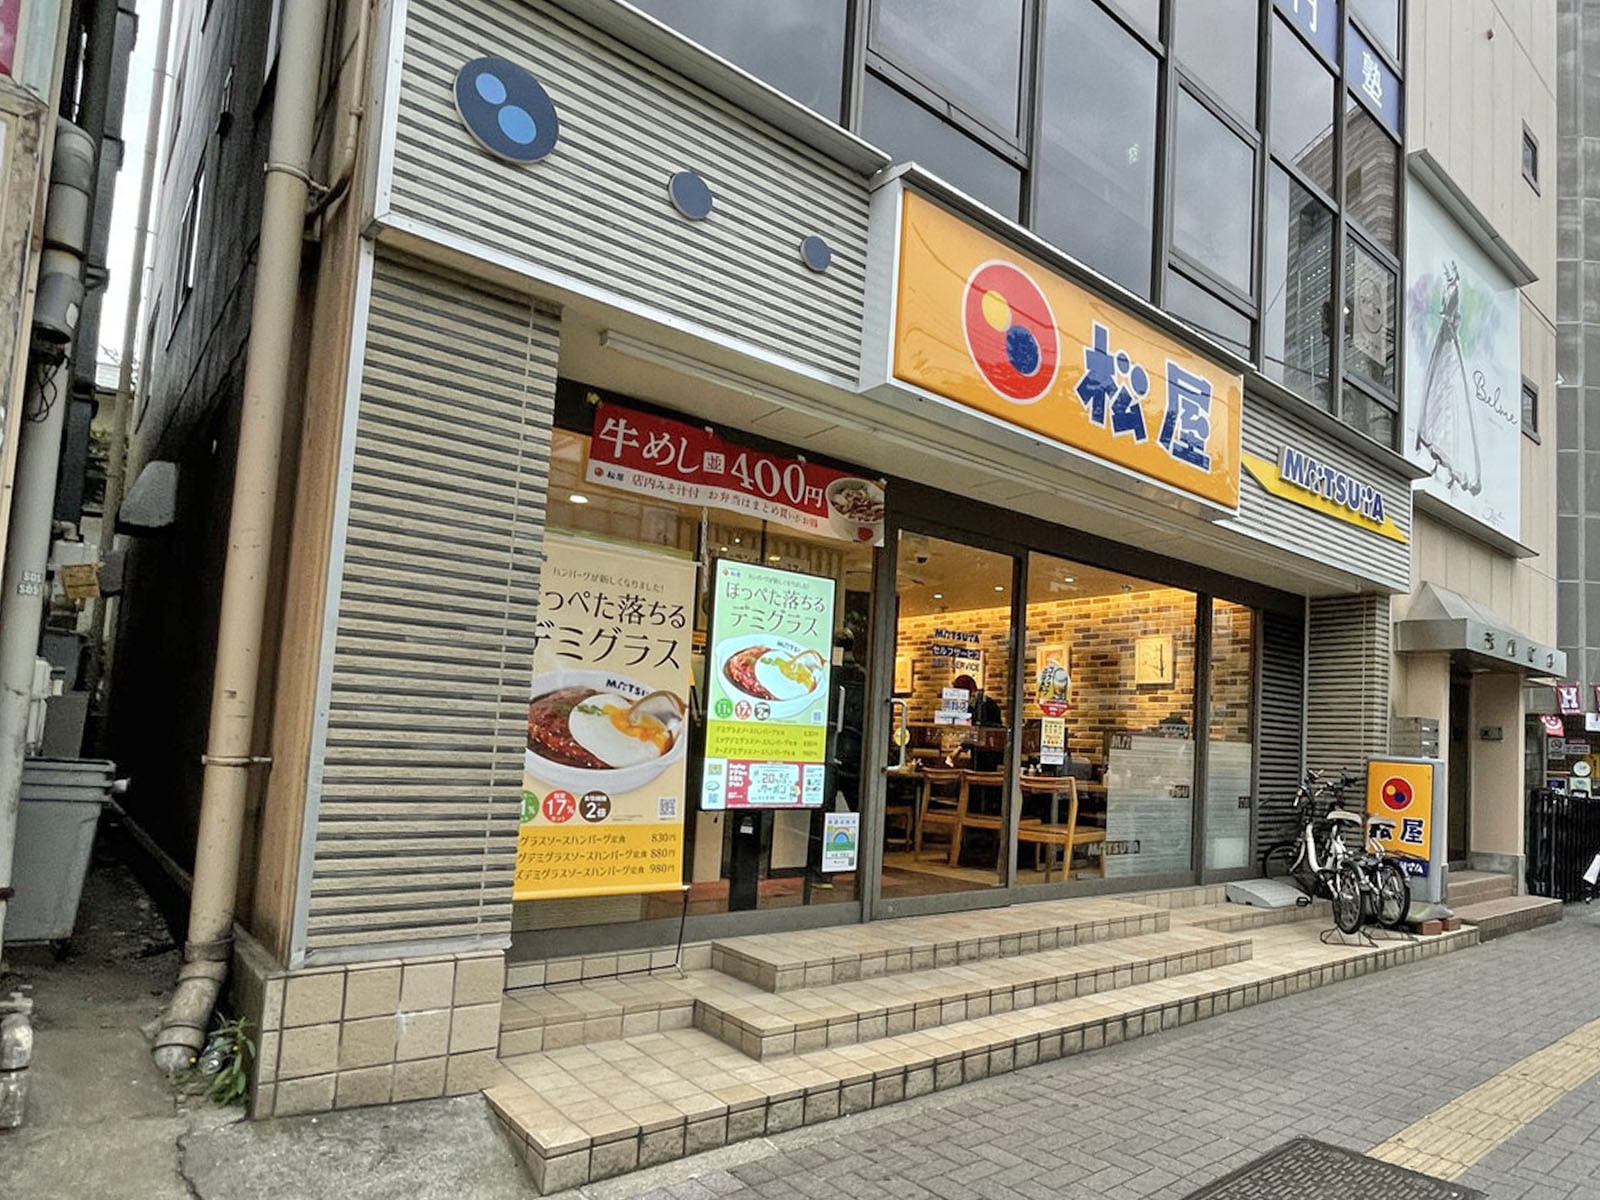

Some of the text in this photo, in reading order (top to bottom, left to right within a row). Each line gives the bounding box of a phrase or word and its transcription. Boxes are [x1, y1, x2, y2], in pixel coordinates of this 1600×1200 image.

[1075, 321, 1213, 474] 松屋
[599, 417, 700, 474] 牛めし
[730, 453, 824, 508] 400円
[1282, 447, 1386, 524] MATSUYA
[536, 619, 680, 670] デミグラス
[730, 604, 818, 637] デミグラス
